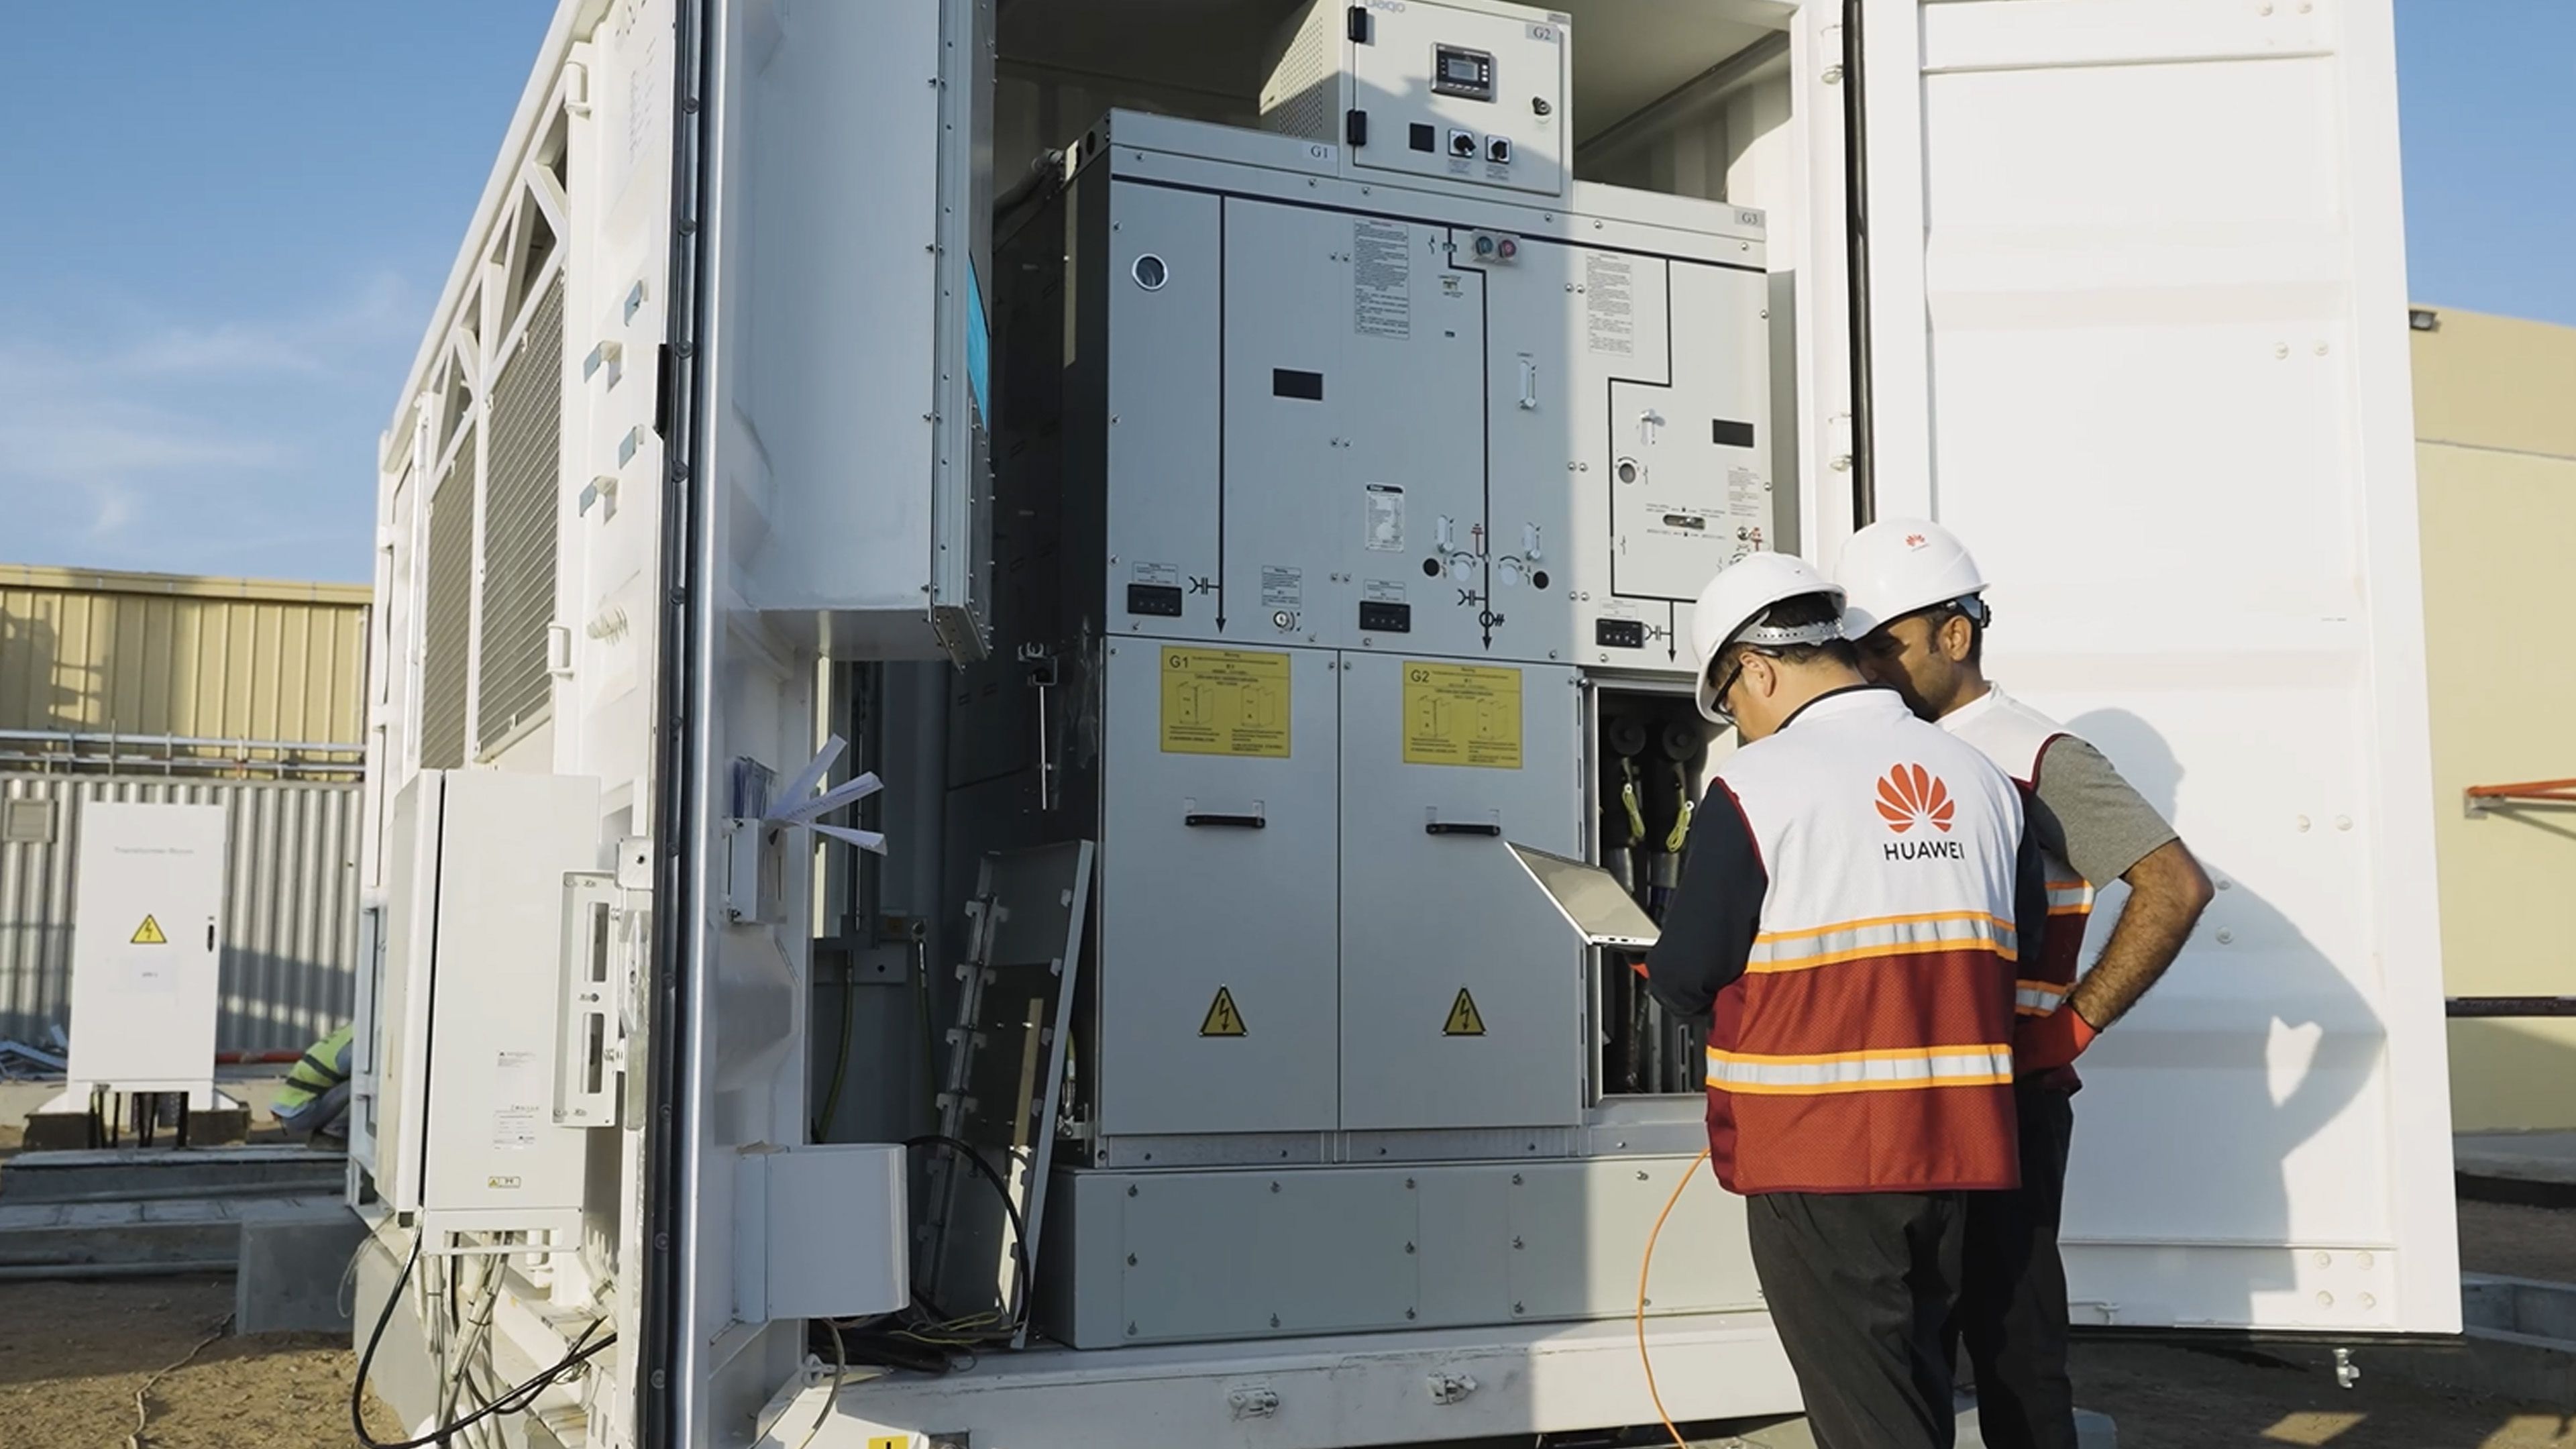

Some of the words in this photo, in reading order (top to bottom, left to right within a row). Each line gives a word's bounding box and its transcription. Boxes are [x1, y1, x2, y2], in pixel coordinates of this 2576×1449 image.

[1533, 26, 1551, 40] G2
[1311, 145, 1328, 158] G1
[1742, 212, 1758, 225] G3
[1169, 655, 1189, 668] G1
[1411, 669, 1430, 683] G2
[1884, 841, 1965, 860] HUAWEI
